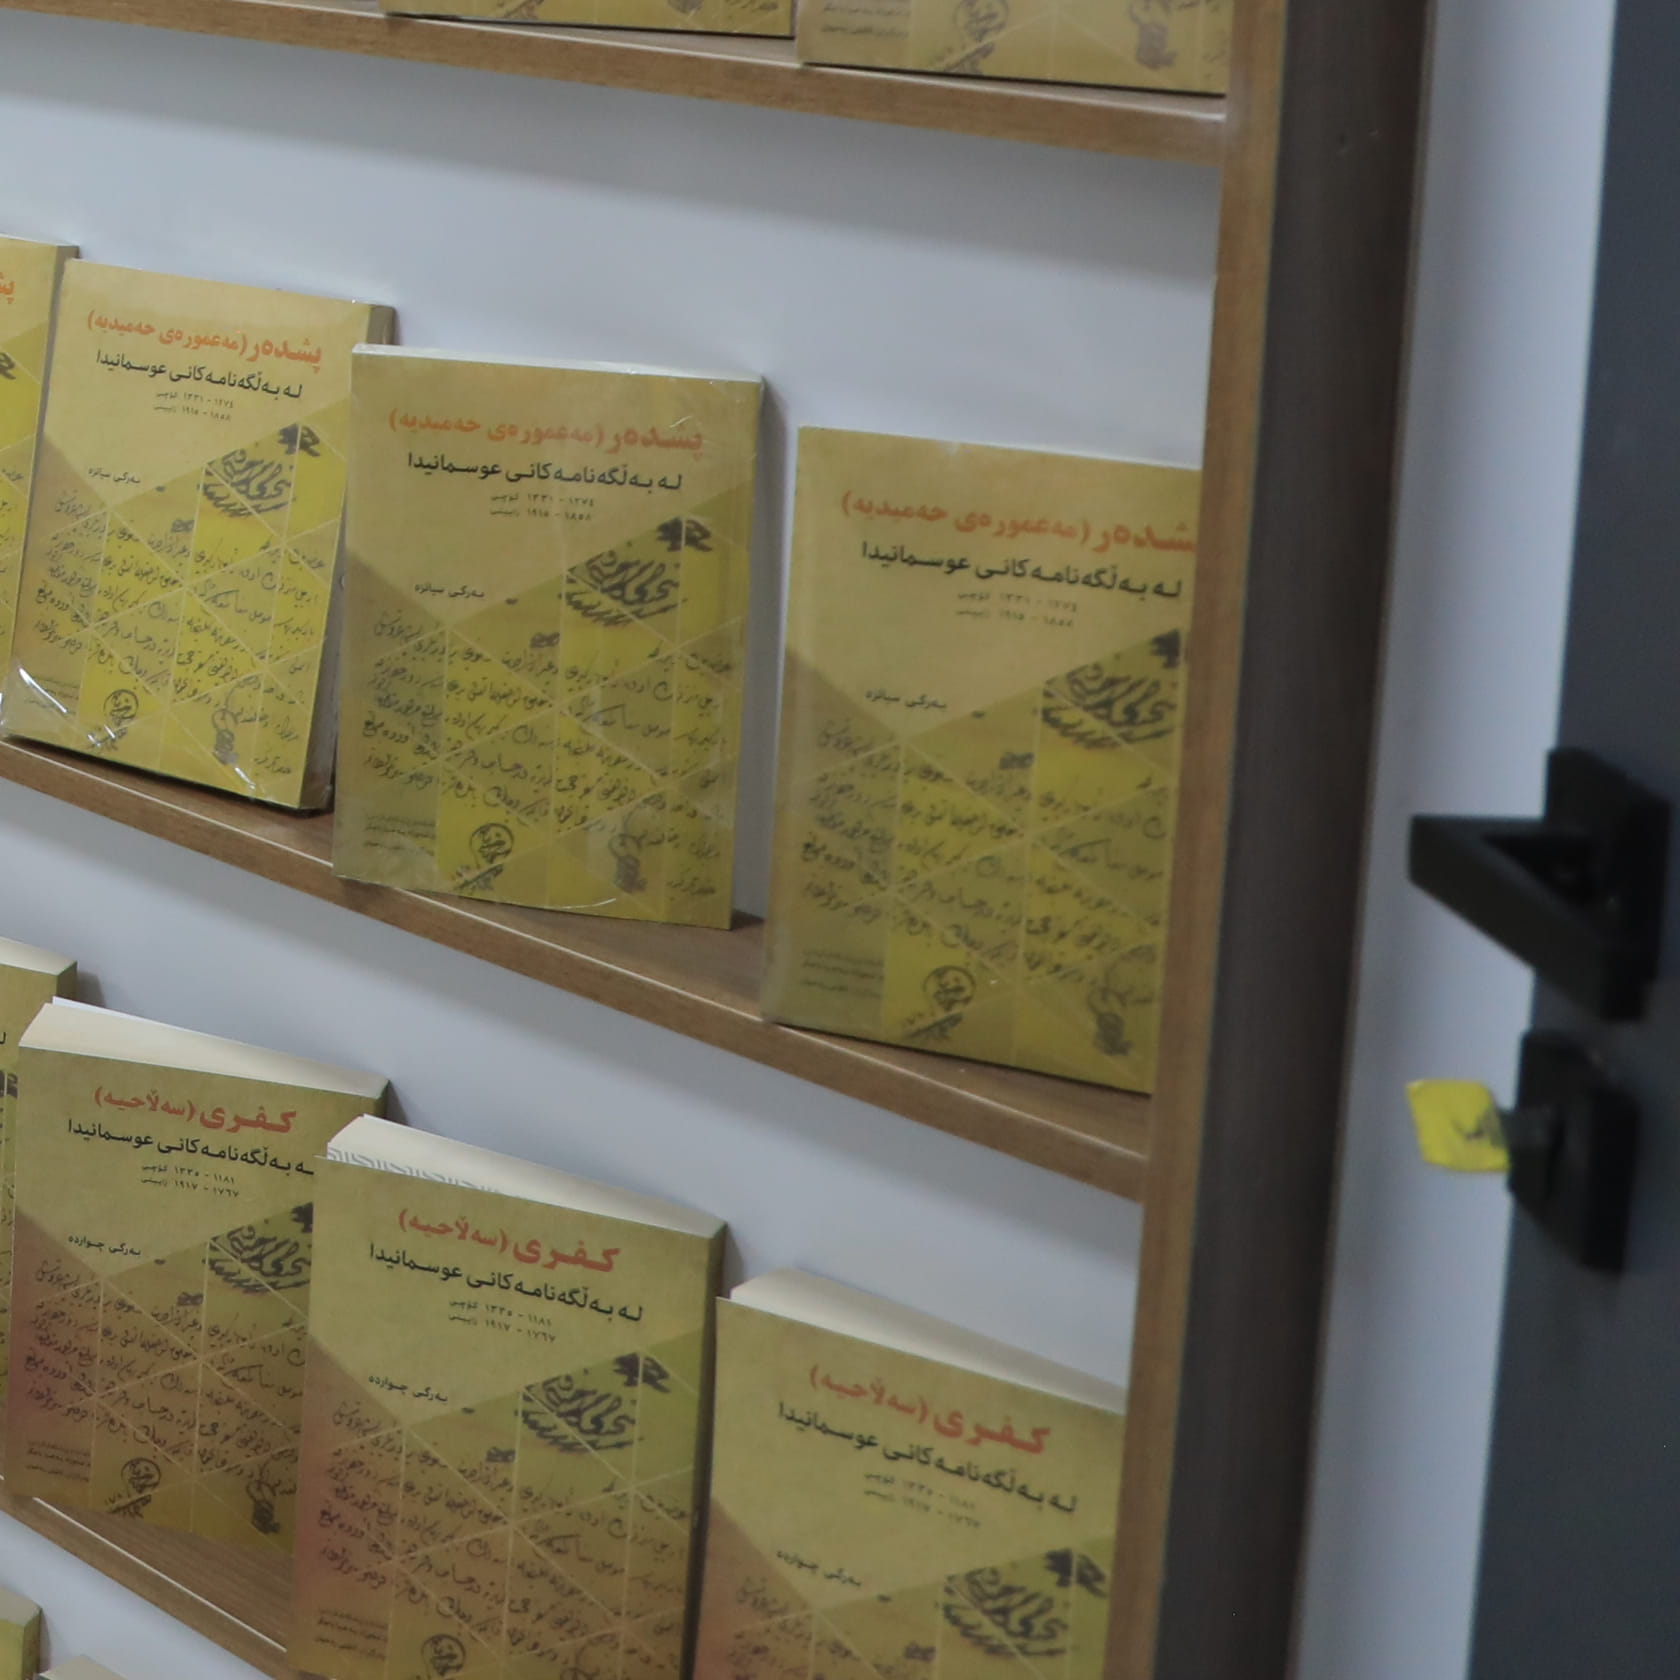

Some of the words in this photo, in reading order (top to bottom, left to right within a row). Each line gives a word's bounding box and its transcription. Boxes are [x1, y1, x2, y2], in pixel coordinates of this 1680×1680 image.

[1092, 521, 1196, 553] شدەر
[200, 1106, 297, 1133] کفری
[513, 1238, 621, 1273] کفری
[933, 1410, 1051, 1454] کفری
